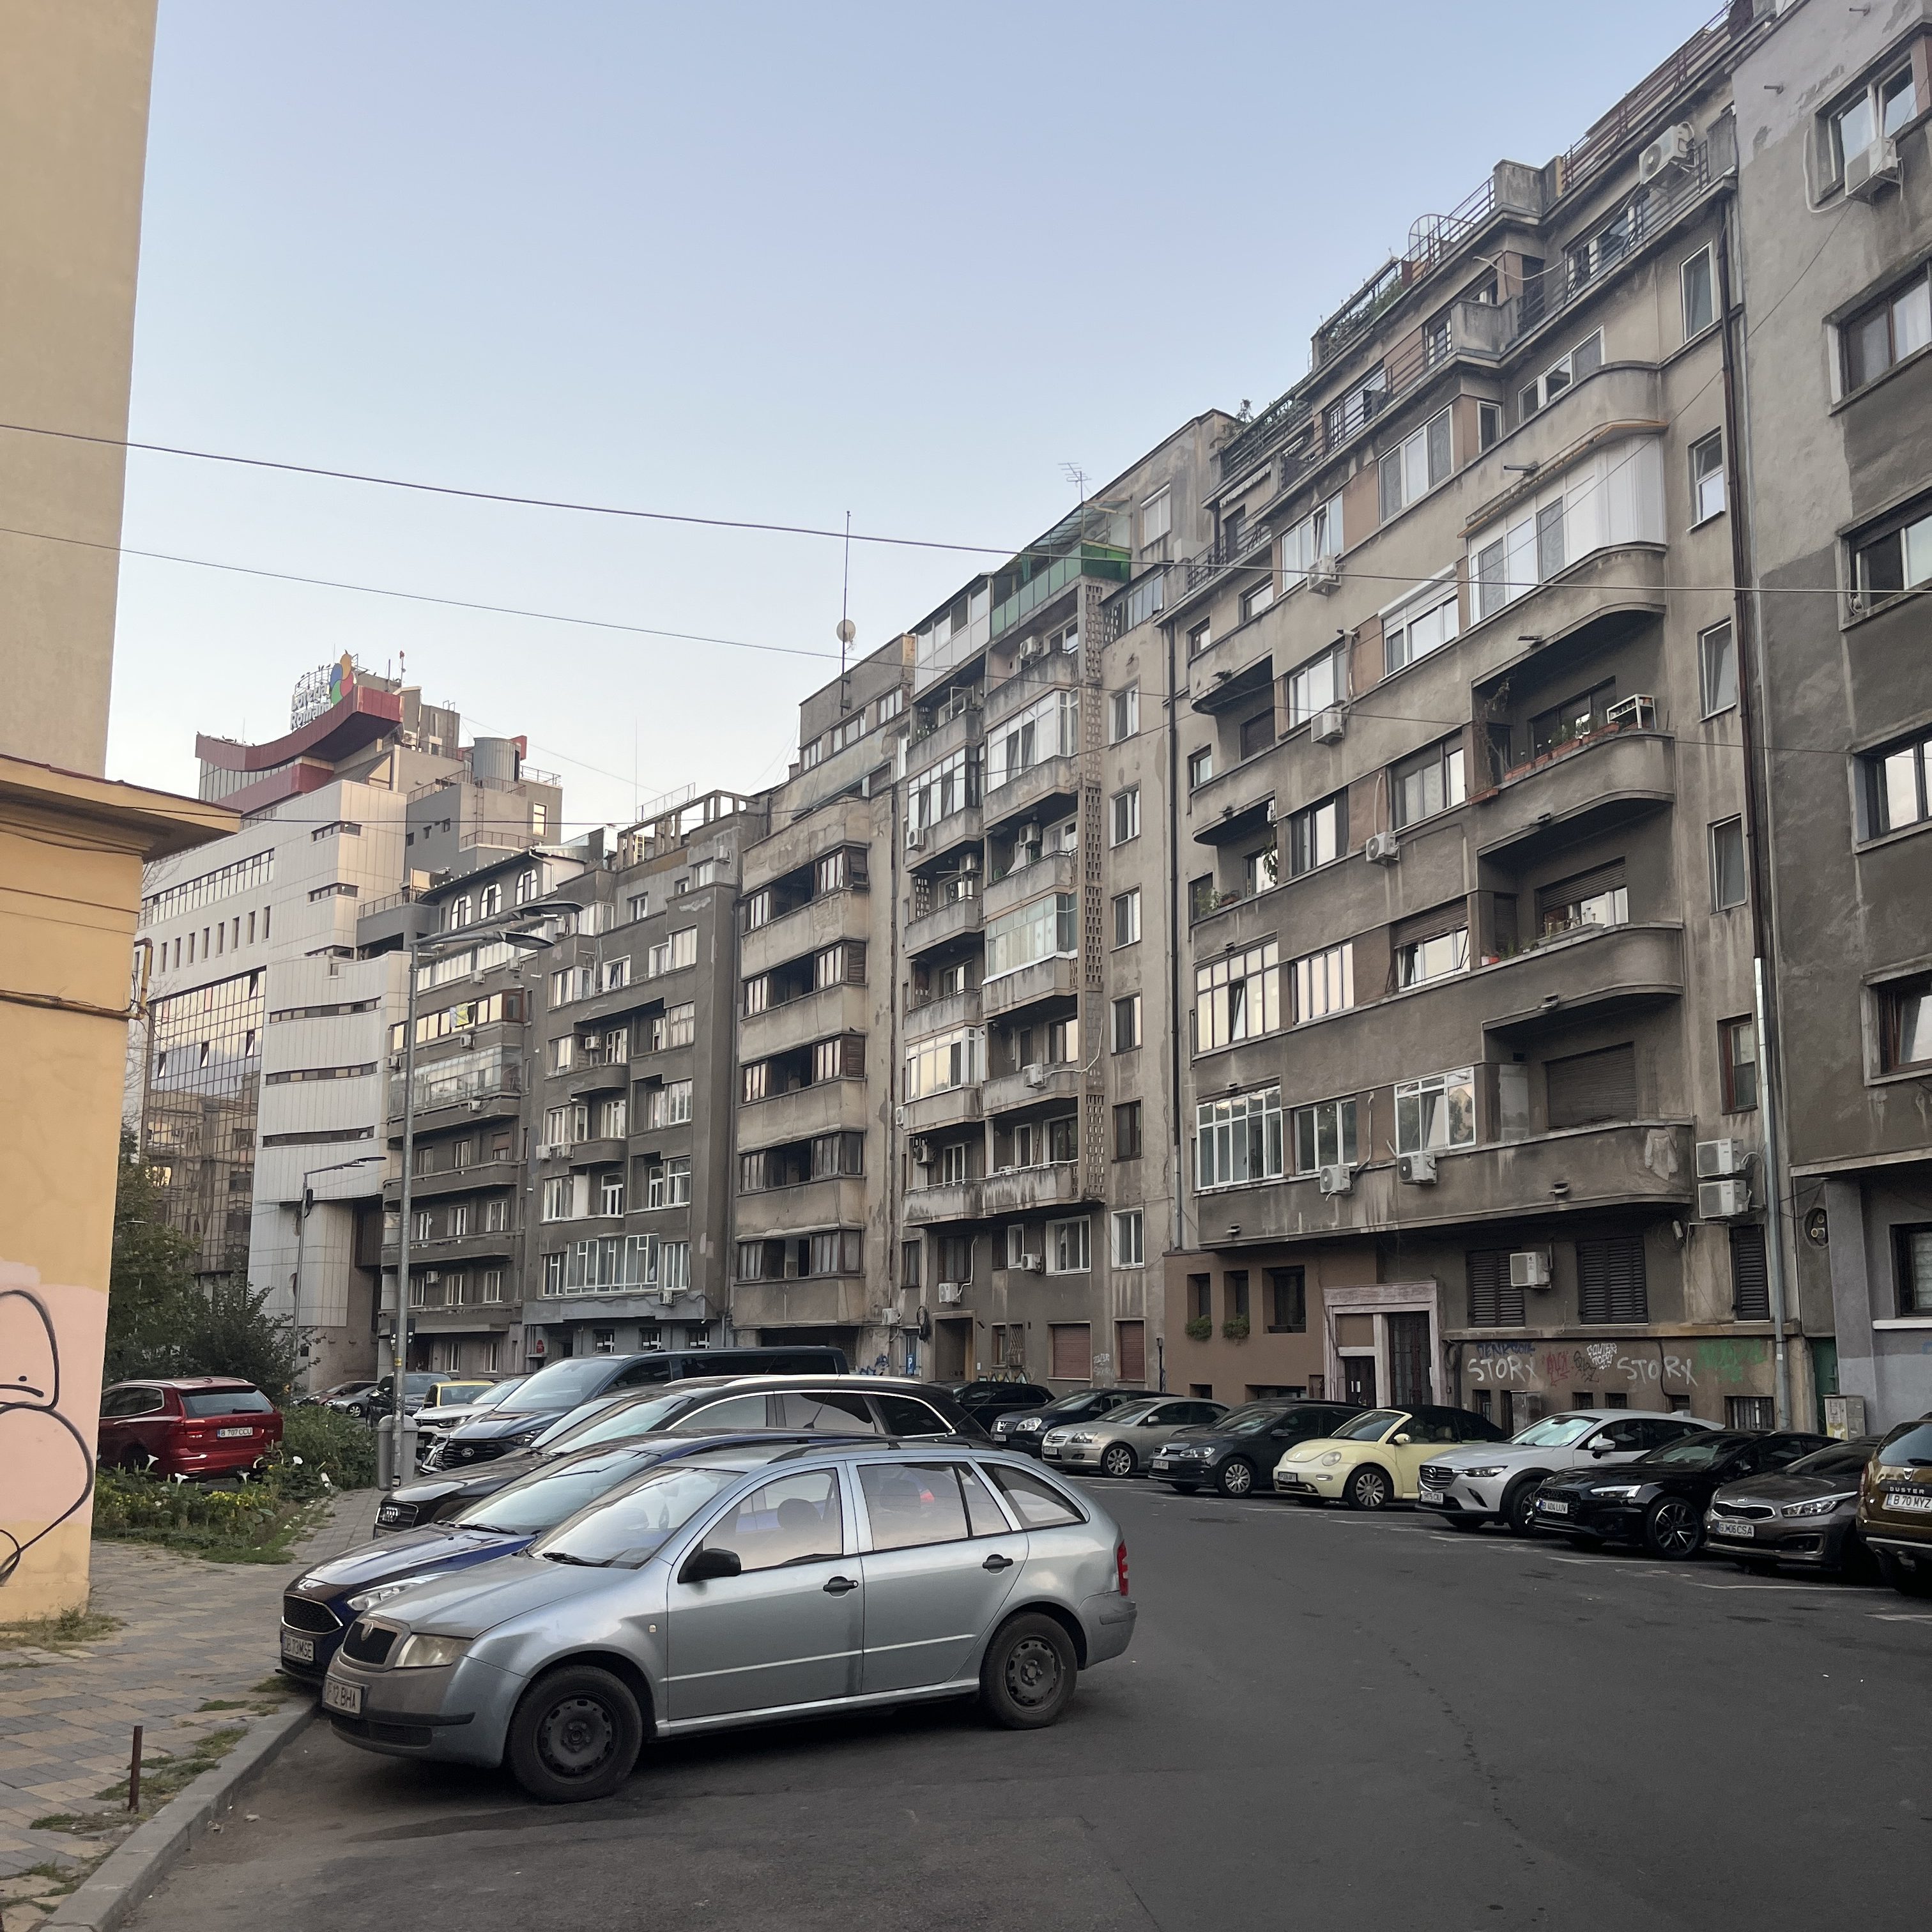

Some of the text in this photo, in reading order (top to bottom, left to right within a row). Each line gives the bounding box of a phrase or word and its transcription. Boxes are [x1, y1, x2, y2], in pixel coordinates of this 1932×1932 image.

[908, 1357, 912, 1368] P
[1889, 1486, 1924, 1494] DUSTER
[1894, 1496, 1931, 1508] B 70 MYZ
[1737, 1526, 1752, 1535] CSA
[341, 1687, 356, 1708] BHA
